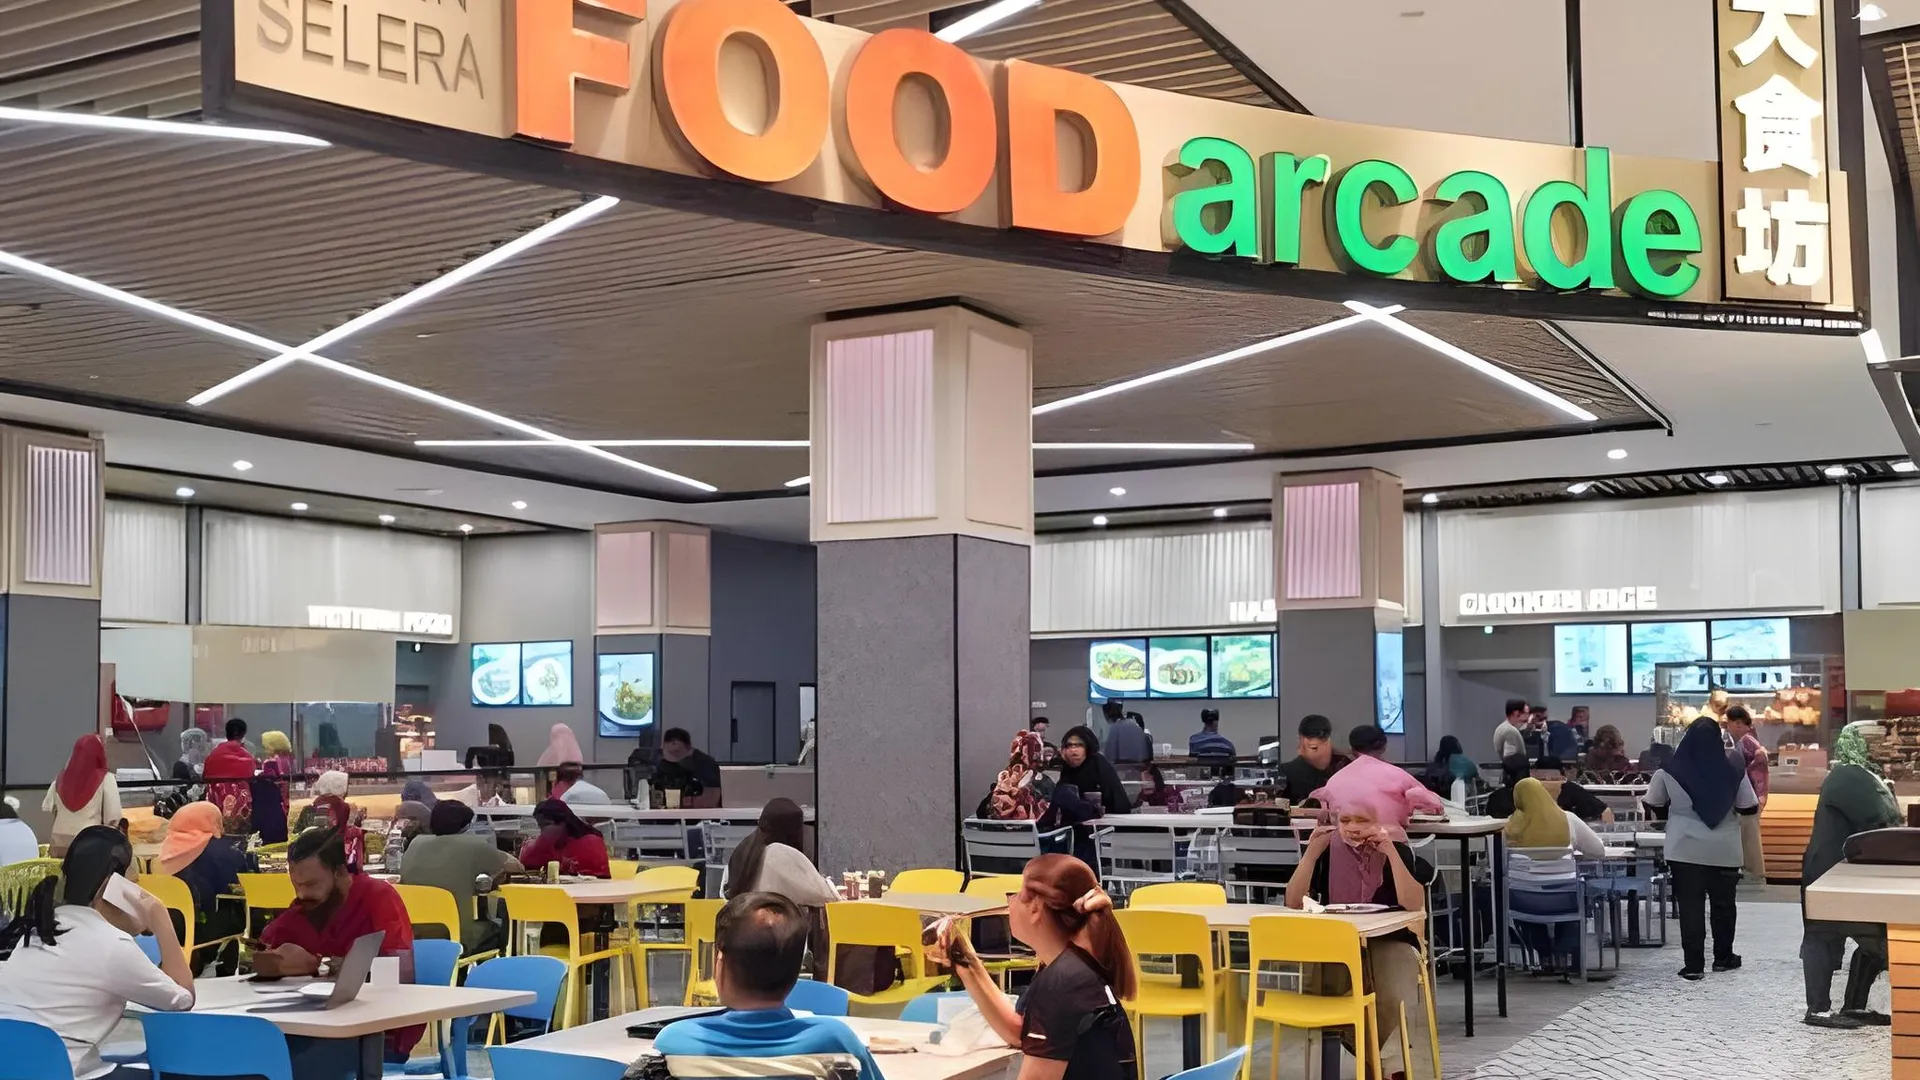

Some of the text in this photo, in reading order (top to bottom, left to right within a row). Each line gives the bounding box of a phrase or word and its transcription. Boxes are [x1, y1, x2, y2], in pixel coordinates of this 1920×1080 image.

[256, 0, 485, 100] SELERA
[515, 0, 1702, 298] FOOD arcade
